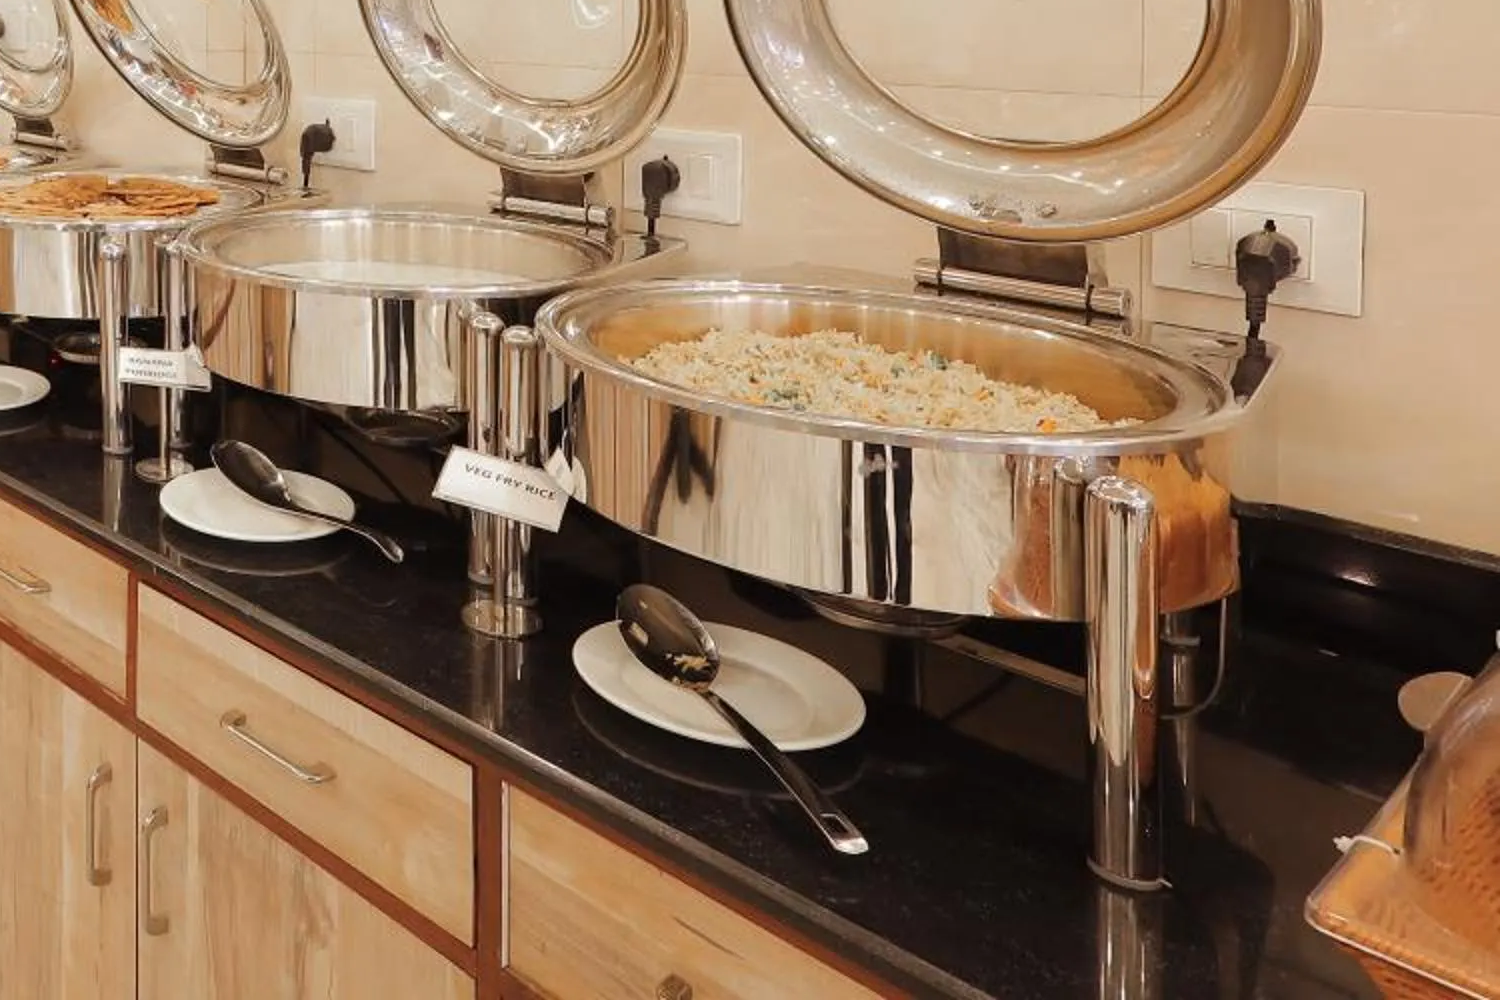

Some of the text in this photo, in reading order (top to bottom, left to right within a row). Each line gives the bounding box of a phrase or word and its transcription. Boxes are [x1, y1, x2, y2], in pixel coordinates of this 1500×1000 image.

[465, 463, 556, 500] VEG FRY RICE
